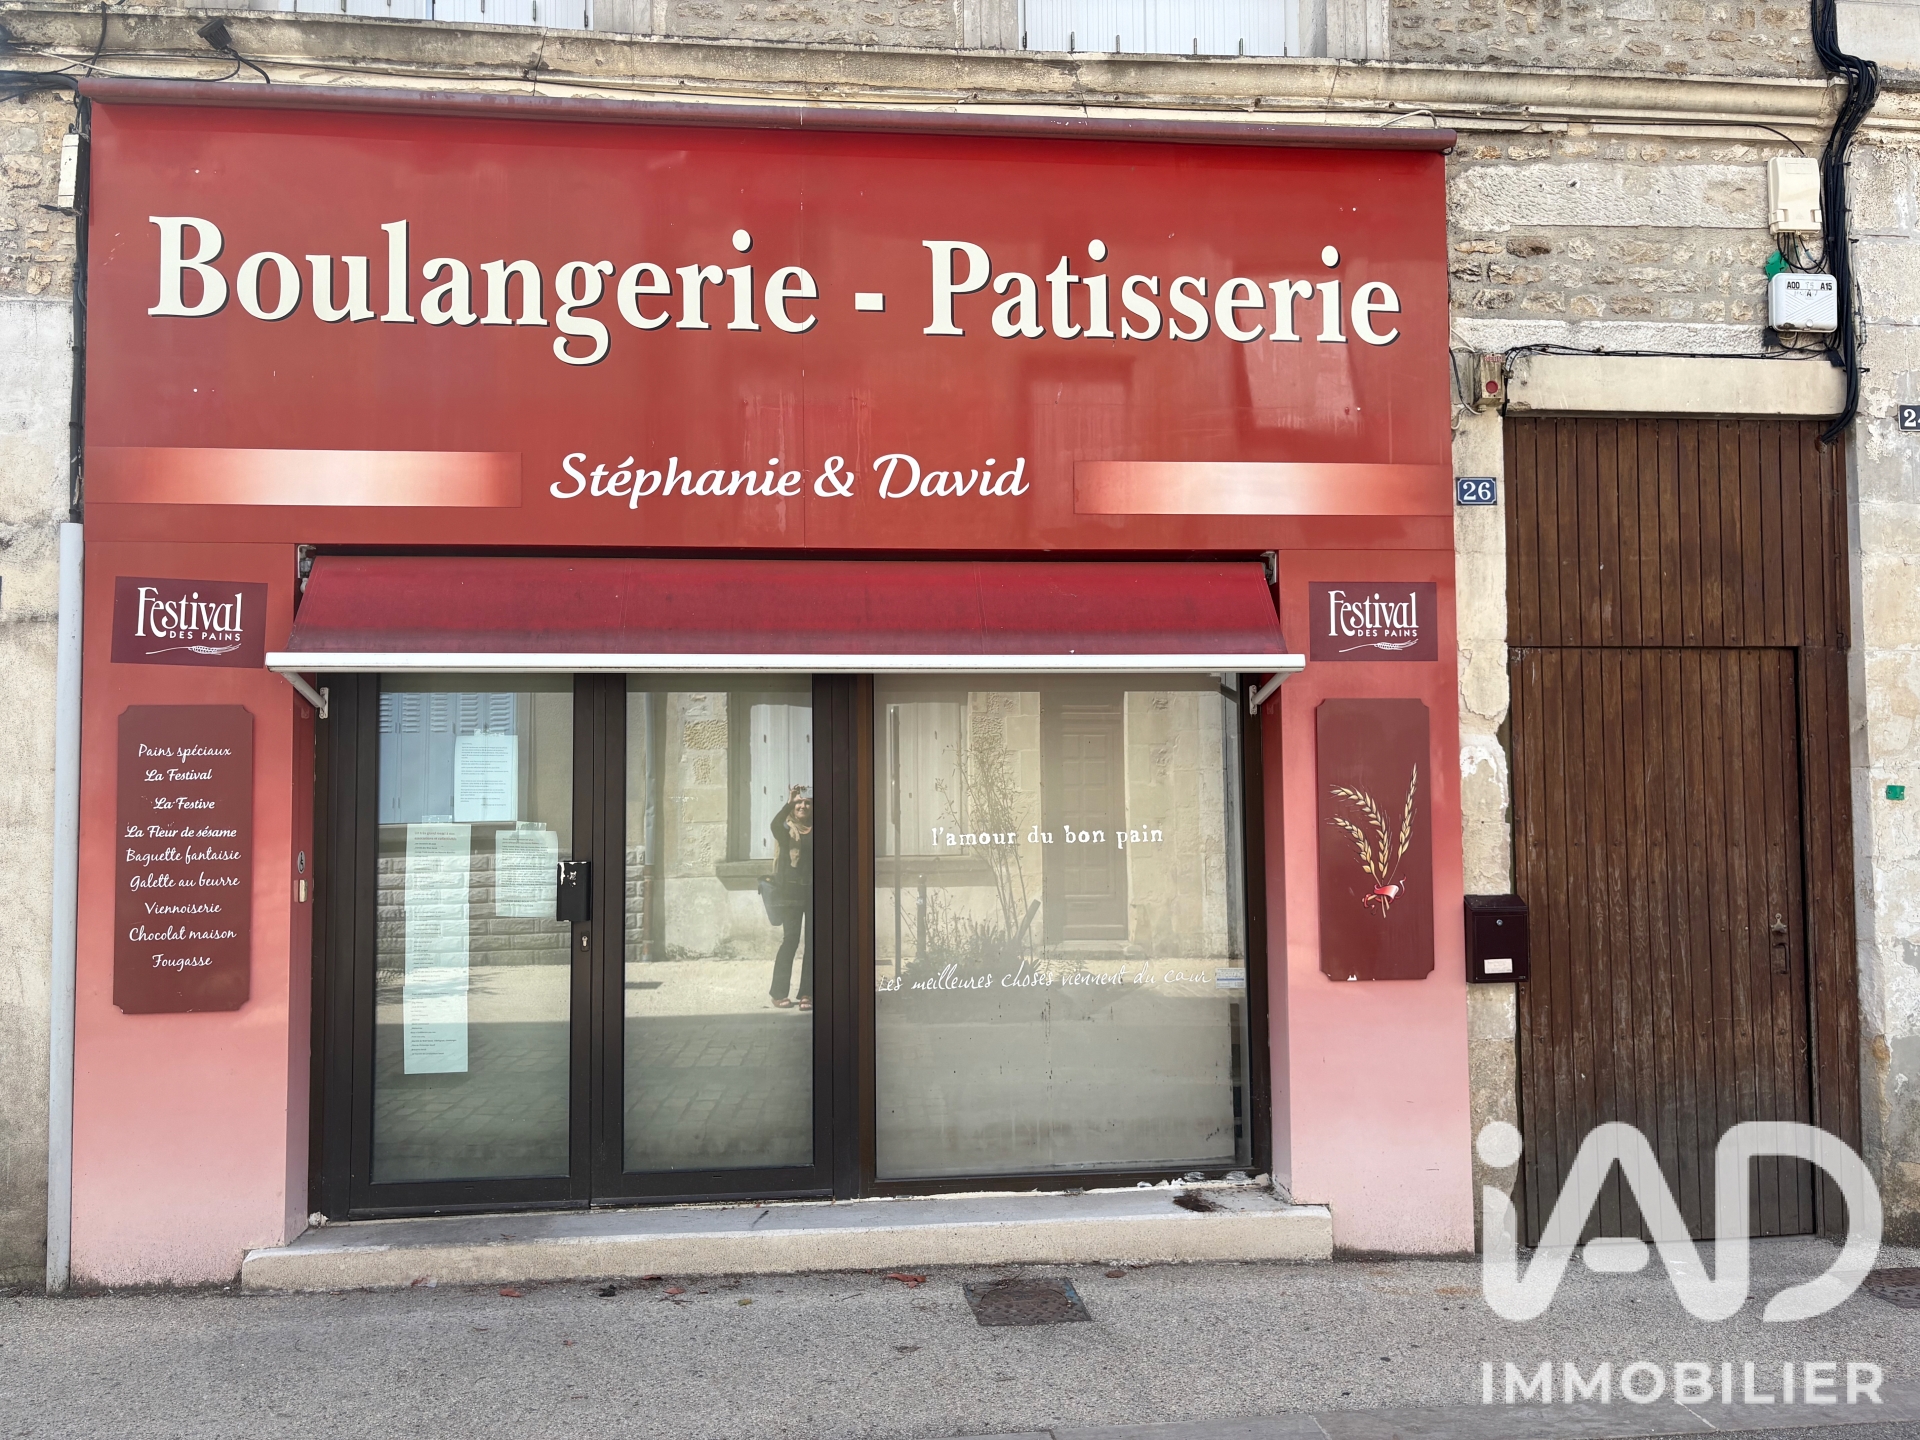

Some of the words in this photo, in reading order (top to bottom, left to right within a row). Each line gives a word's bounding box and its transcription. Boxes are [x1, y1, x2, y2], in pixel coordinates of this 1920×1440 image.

[147, 215, 819, 366] Boulangerie
[855, 293, 885, 311] -
[922, 239, 1402, 346] Patisserie
[1904, 408, 1920, 427] 2
[550, 452, 801, 509] Stéphanie
[813, 455, 855, 498] &
[872, 453, 1030, 500] David
[1462, 481, 1491, 501] 26
[134, 586, 244, 638] Festival
[1327, 589, 1419, 637] Festival
[169, 630, 194, 639] DES
[201, 631, 241, 641] PAINS
[1357, 629, 1378, 637] DES
[1384, 629, 1418, 638] PAINS
[138, 743, 174, 757] Pains
[176, 744, 232, 764] spéciaux
[144, 769, 164, 781] La
[166, 768, 213, 781] Festival
[153, 797, 173, 809] La
[175, 797, 215, 810] Festive
[124, 825, 144, 838] La
[147, 825, 179, 838] Fleur
[181, 826, 195, 838] de
[196, 826, 237, 838] sésame
[931, 827, 1016, 847] l'amour
[1027, 826, 1054, 844] du
[1063, 825, 1106, 844] bon
[1115, 825, 1163, 849] pain
[126, 848, 182, 867] Baguette
[185, 845, 241, 864] fantaisie
[129, 873, 176, 892] Galette
[178, 880, 196, 888] au
[198, 871, 240, 887] beurre
[144, 902, 222, 914] Viennoiserie
[129, 925, 187, 941] Chocolat
[188, 929, 237, 940] maison
[152, 953, 213, 972] Fougasse
[878, 974, 903, 992] Les
[911, 963, 994, 990] meilleures
[1001, 960, 1055, 988] choses
[1061, 964, 1129, 987] viennent
[1133, 961, 1157, 985] du
